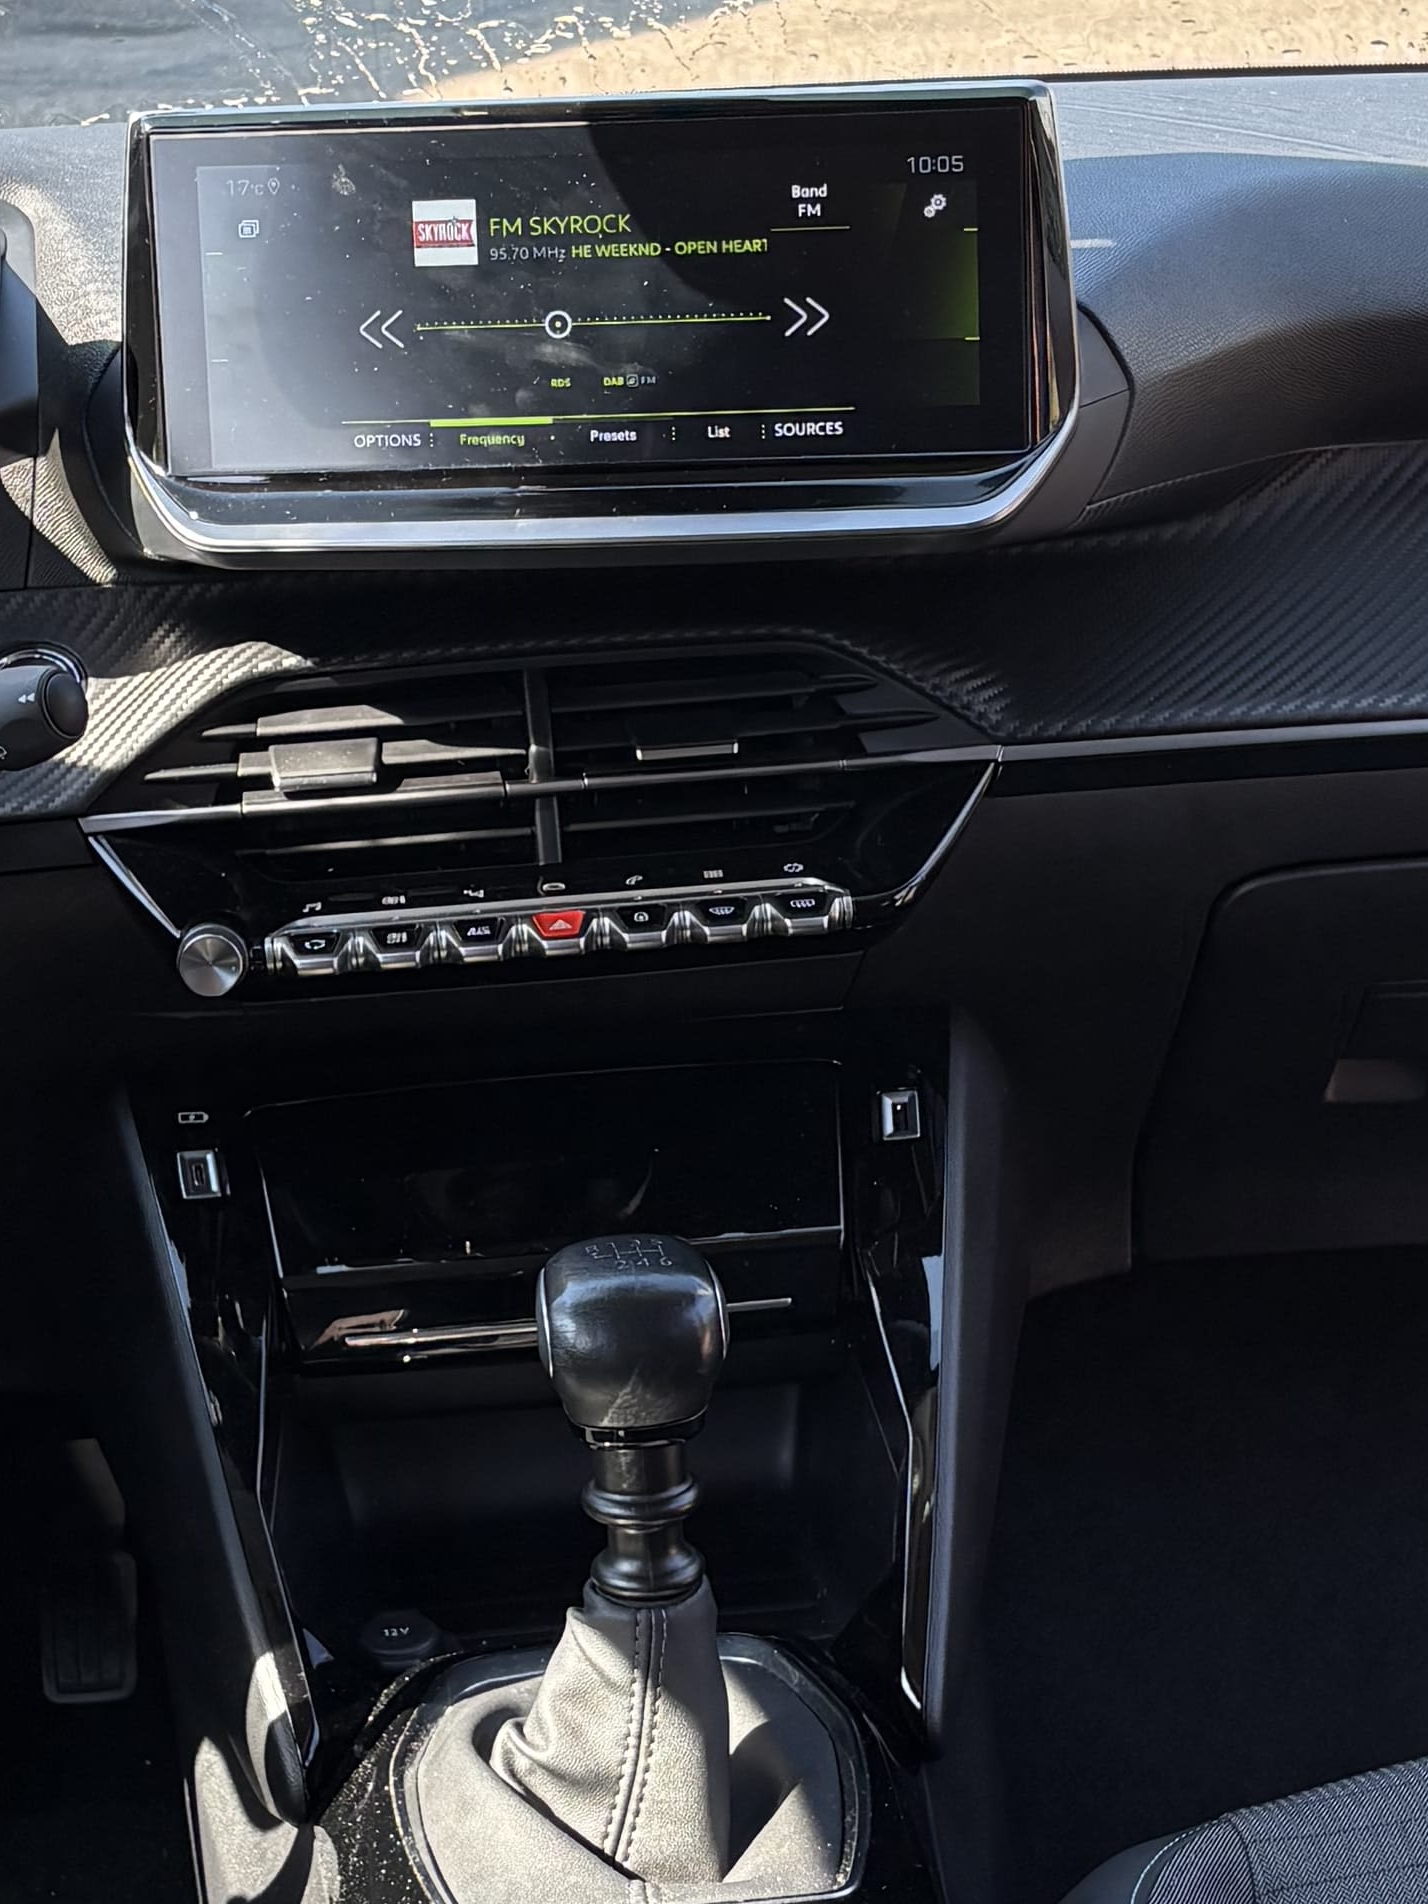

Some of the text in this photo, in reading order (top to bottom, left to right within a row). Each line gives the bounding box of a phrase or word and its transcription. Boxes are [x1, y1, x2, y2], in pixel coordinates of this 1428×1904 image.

[907, 155, 965, 174] 10:05
[791, 183, 828, 198] Band
[797, 203, 822, 217] FM
[417, 221, 471, 243] SKYROCK
[489, 213, 632, 238] FM SKYROCK
[489, 245, 567, 261] 95.70 MHz
[571, 245, 593, 259] HE
[595, 242, 662, 258] WEEKND
[674, 239, 718, 256] OPEN
[550, 377, 572, 388] RDS
[603, 376, 624, 387] DAB
[589, 428, 637, 442] Presets
[706, 425, 731, 438] List
[773, 421, 844, 437] SOURCES
[353, 433, 422, 448] OPTIONS
[459, 432, 525, 448] Frequency
[383, 1626, 410, 1637] 12V
